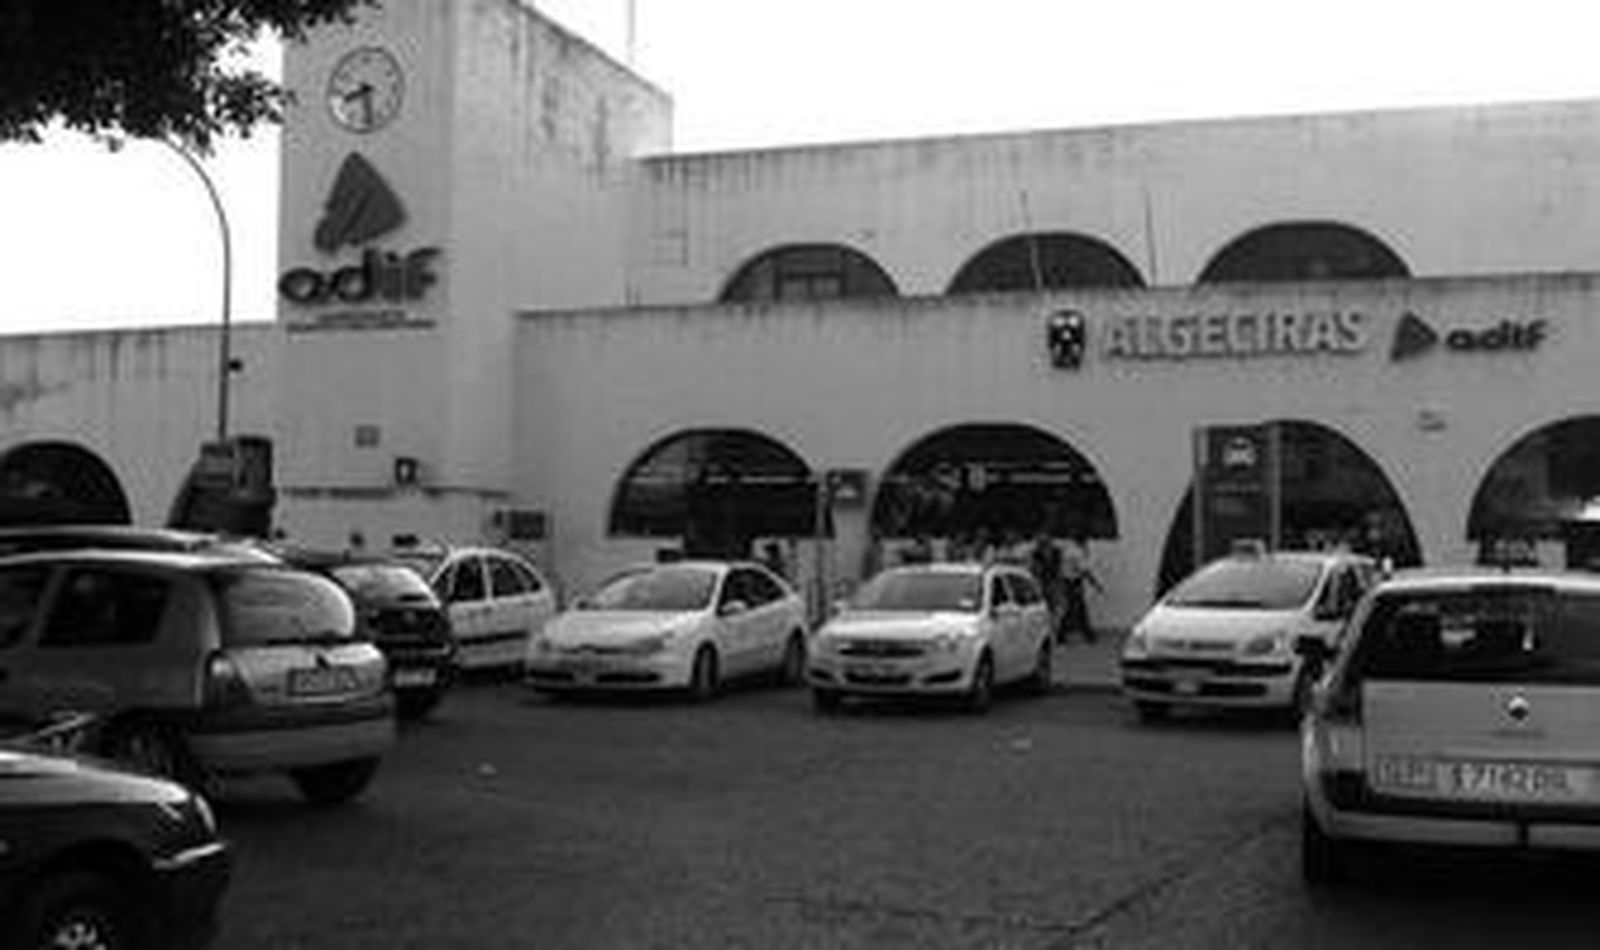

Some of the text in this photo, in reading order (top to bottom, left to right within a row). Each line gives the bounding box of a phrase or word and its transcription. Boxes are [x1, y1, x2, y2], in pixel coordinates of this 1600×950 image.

[279, 247, 443, 306] adif
[1101, 309, 1549, 358] ALGECIRAS adif
